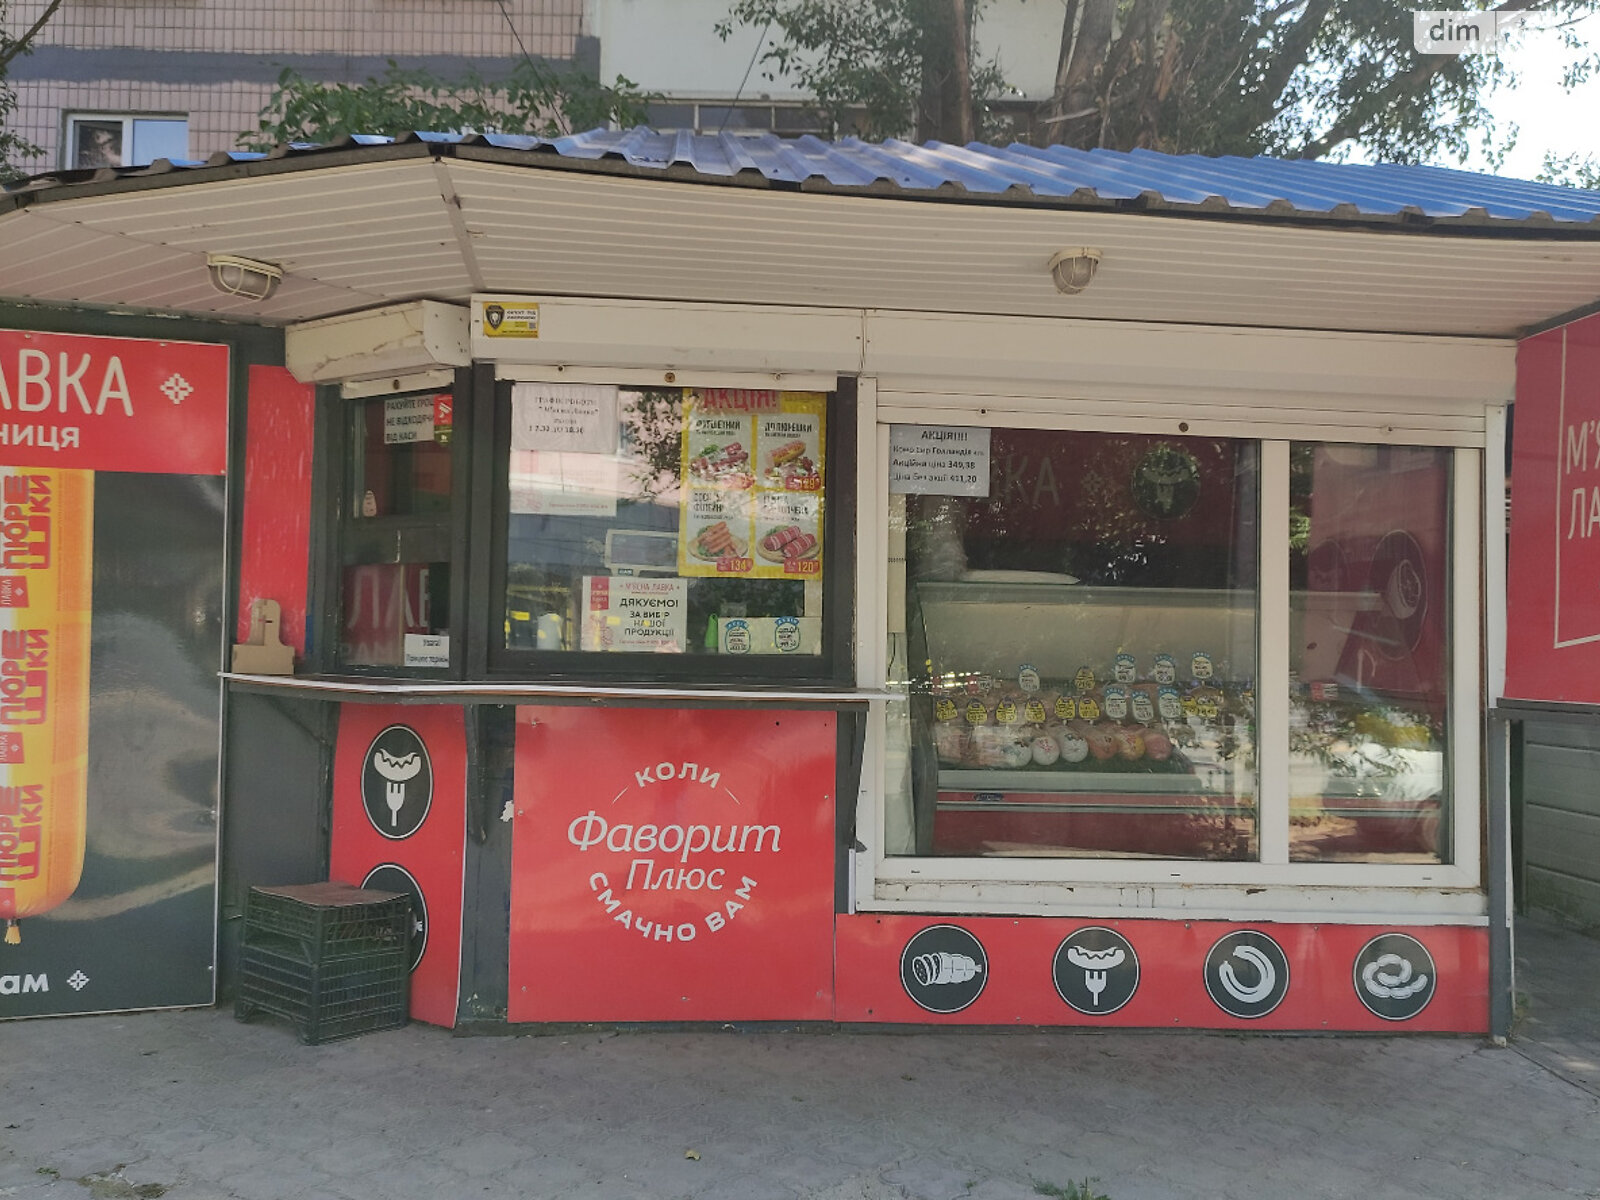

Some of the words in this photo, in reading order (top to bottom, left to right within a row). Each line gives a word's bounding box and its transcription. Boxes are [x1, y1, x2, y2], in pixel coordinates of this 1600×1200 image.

[1566, 419, 1600, 475] М'
[634, 762, 722, 789] КОЛИ
[567, 810, 782, 863] Фаворит
[625, 858, 726, 890] Плюс
[589, 871, 697, 942] СМАЧНО
[704, 875, 758, 933] ВАМ
